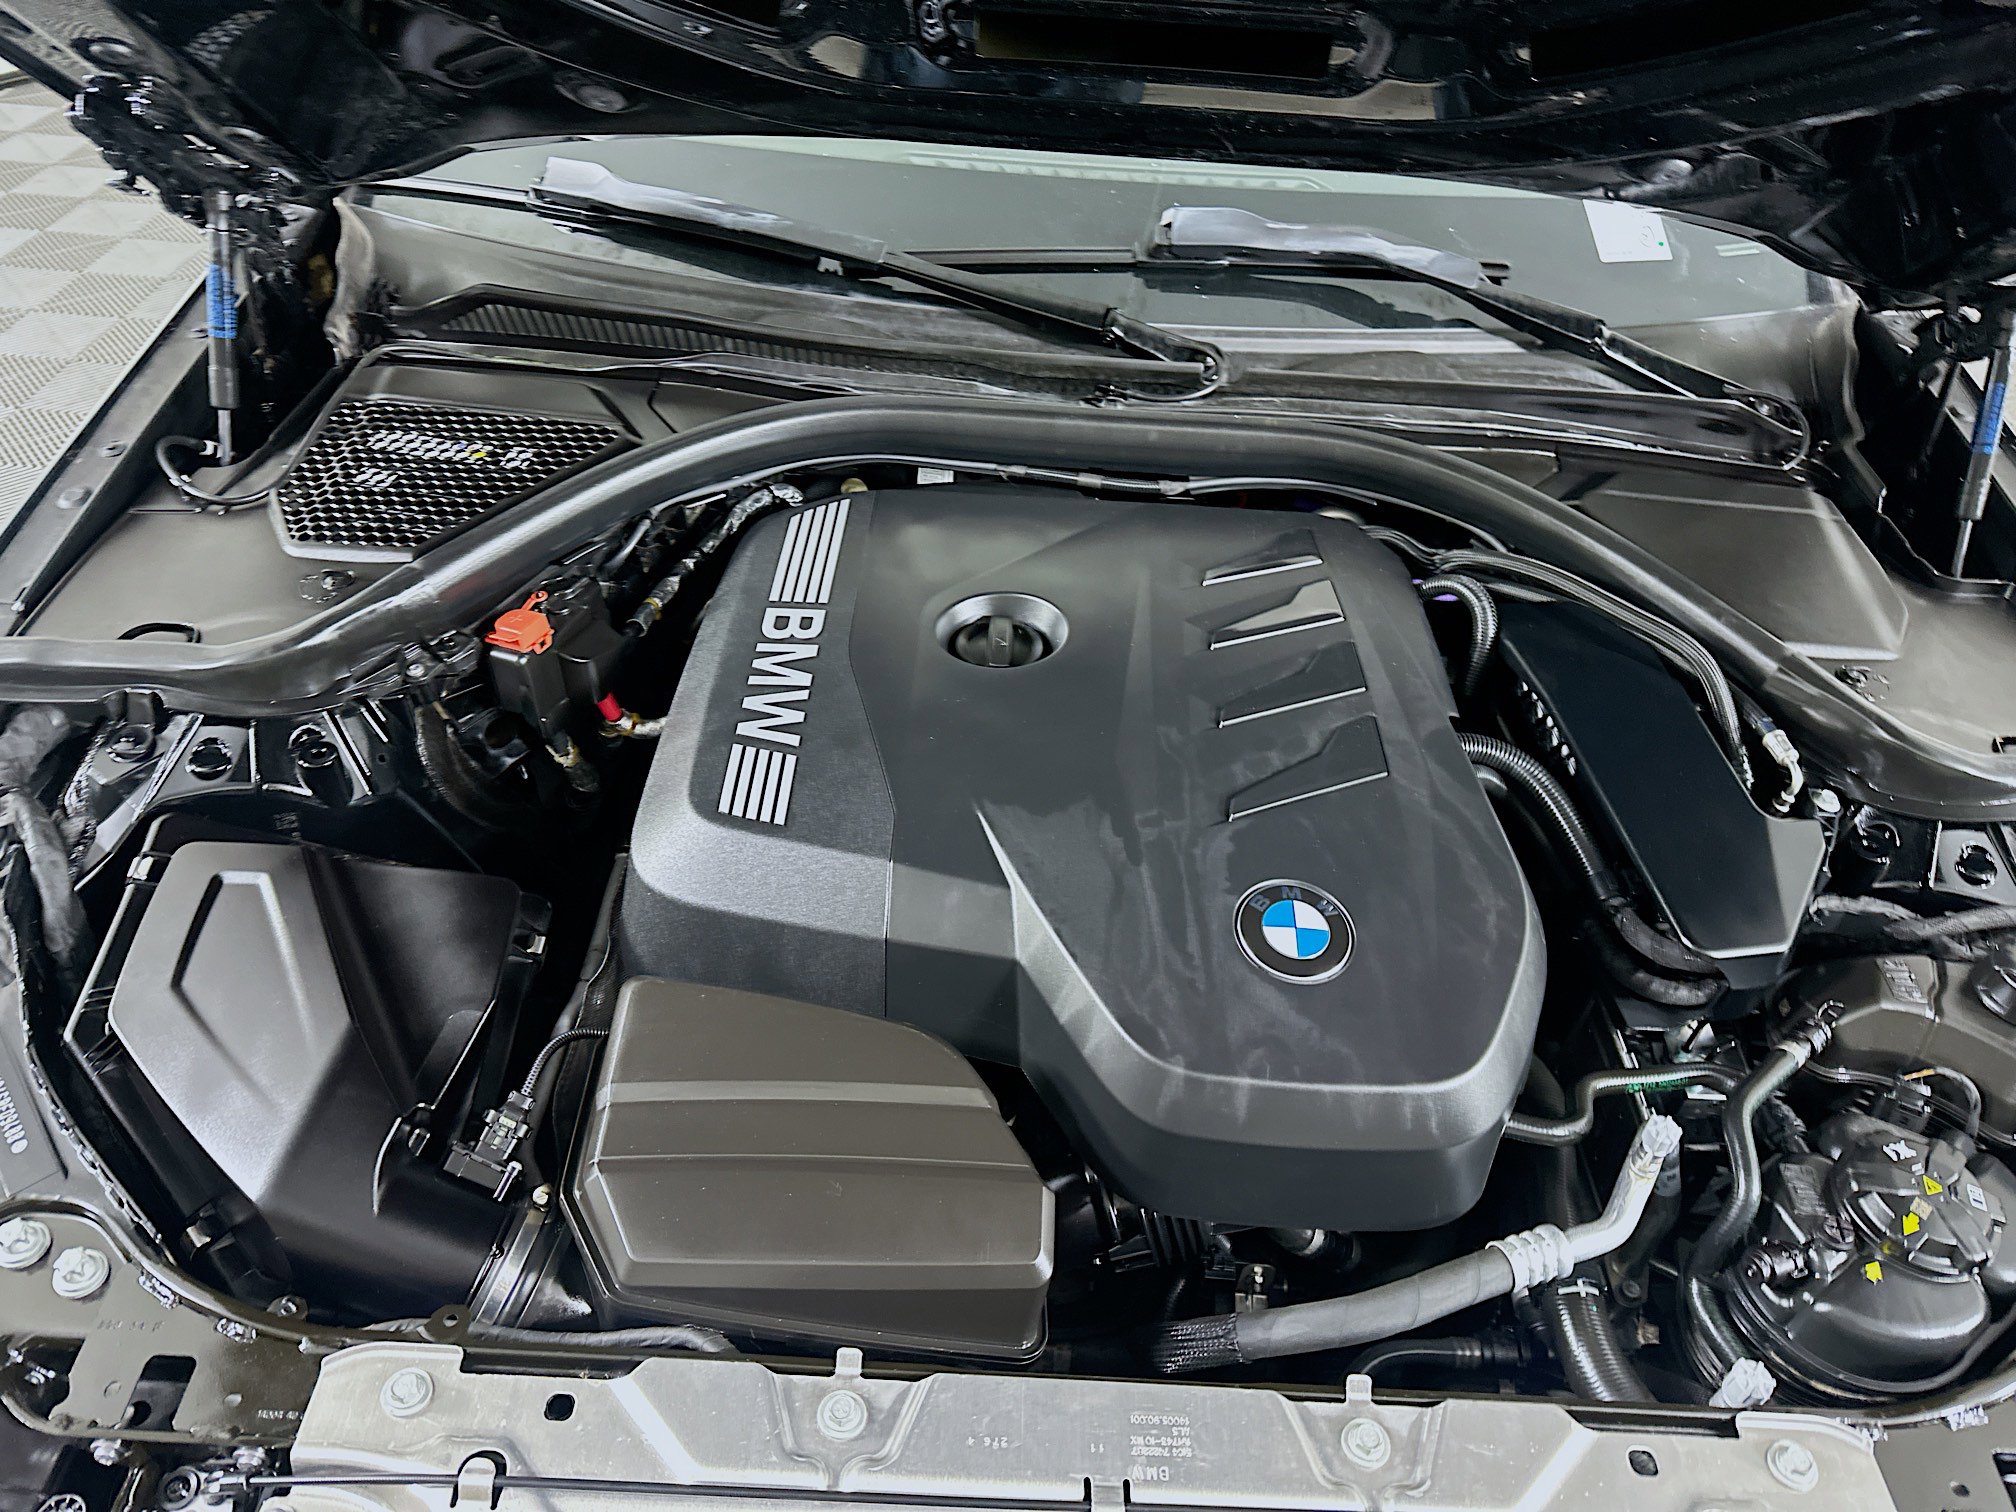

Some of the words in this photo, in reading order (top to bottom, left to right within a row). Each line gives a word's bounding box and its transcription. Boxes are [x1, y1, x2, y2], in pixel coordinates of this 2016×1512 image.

[736, 608, 826, 747] BMW
[1248, 886, 1339, 916] BMW
[1131, 1465, 1170, 1481] BMW
